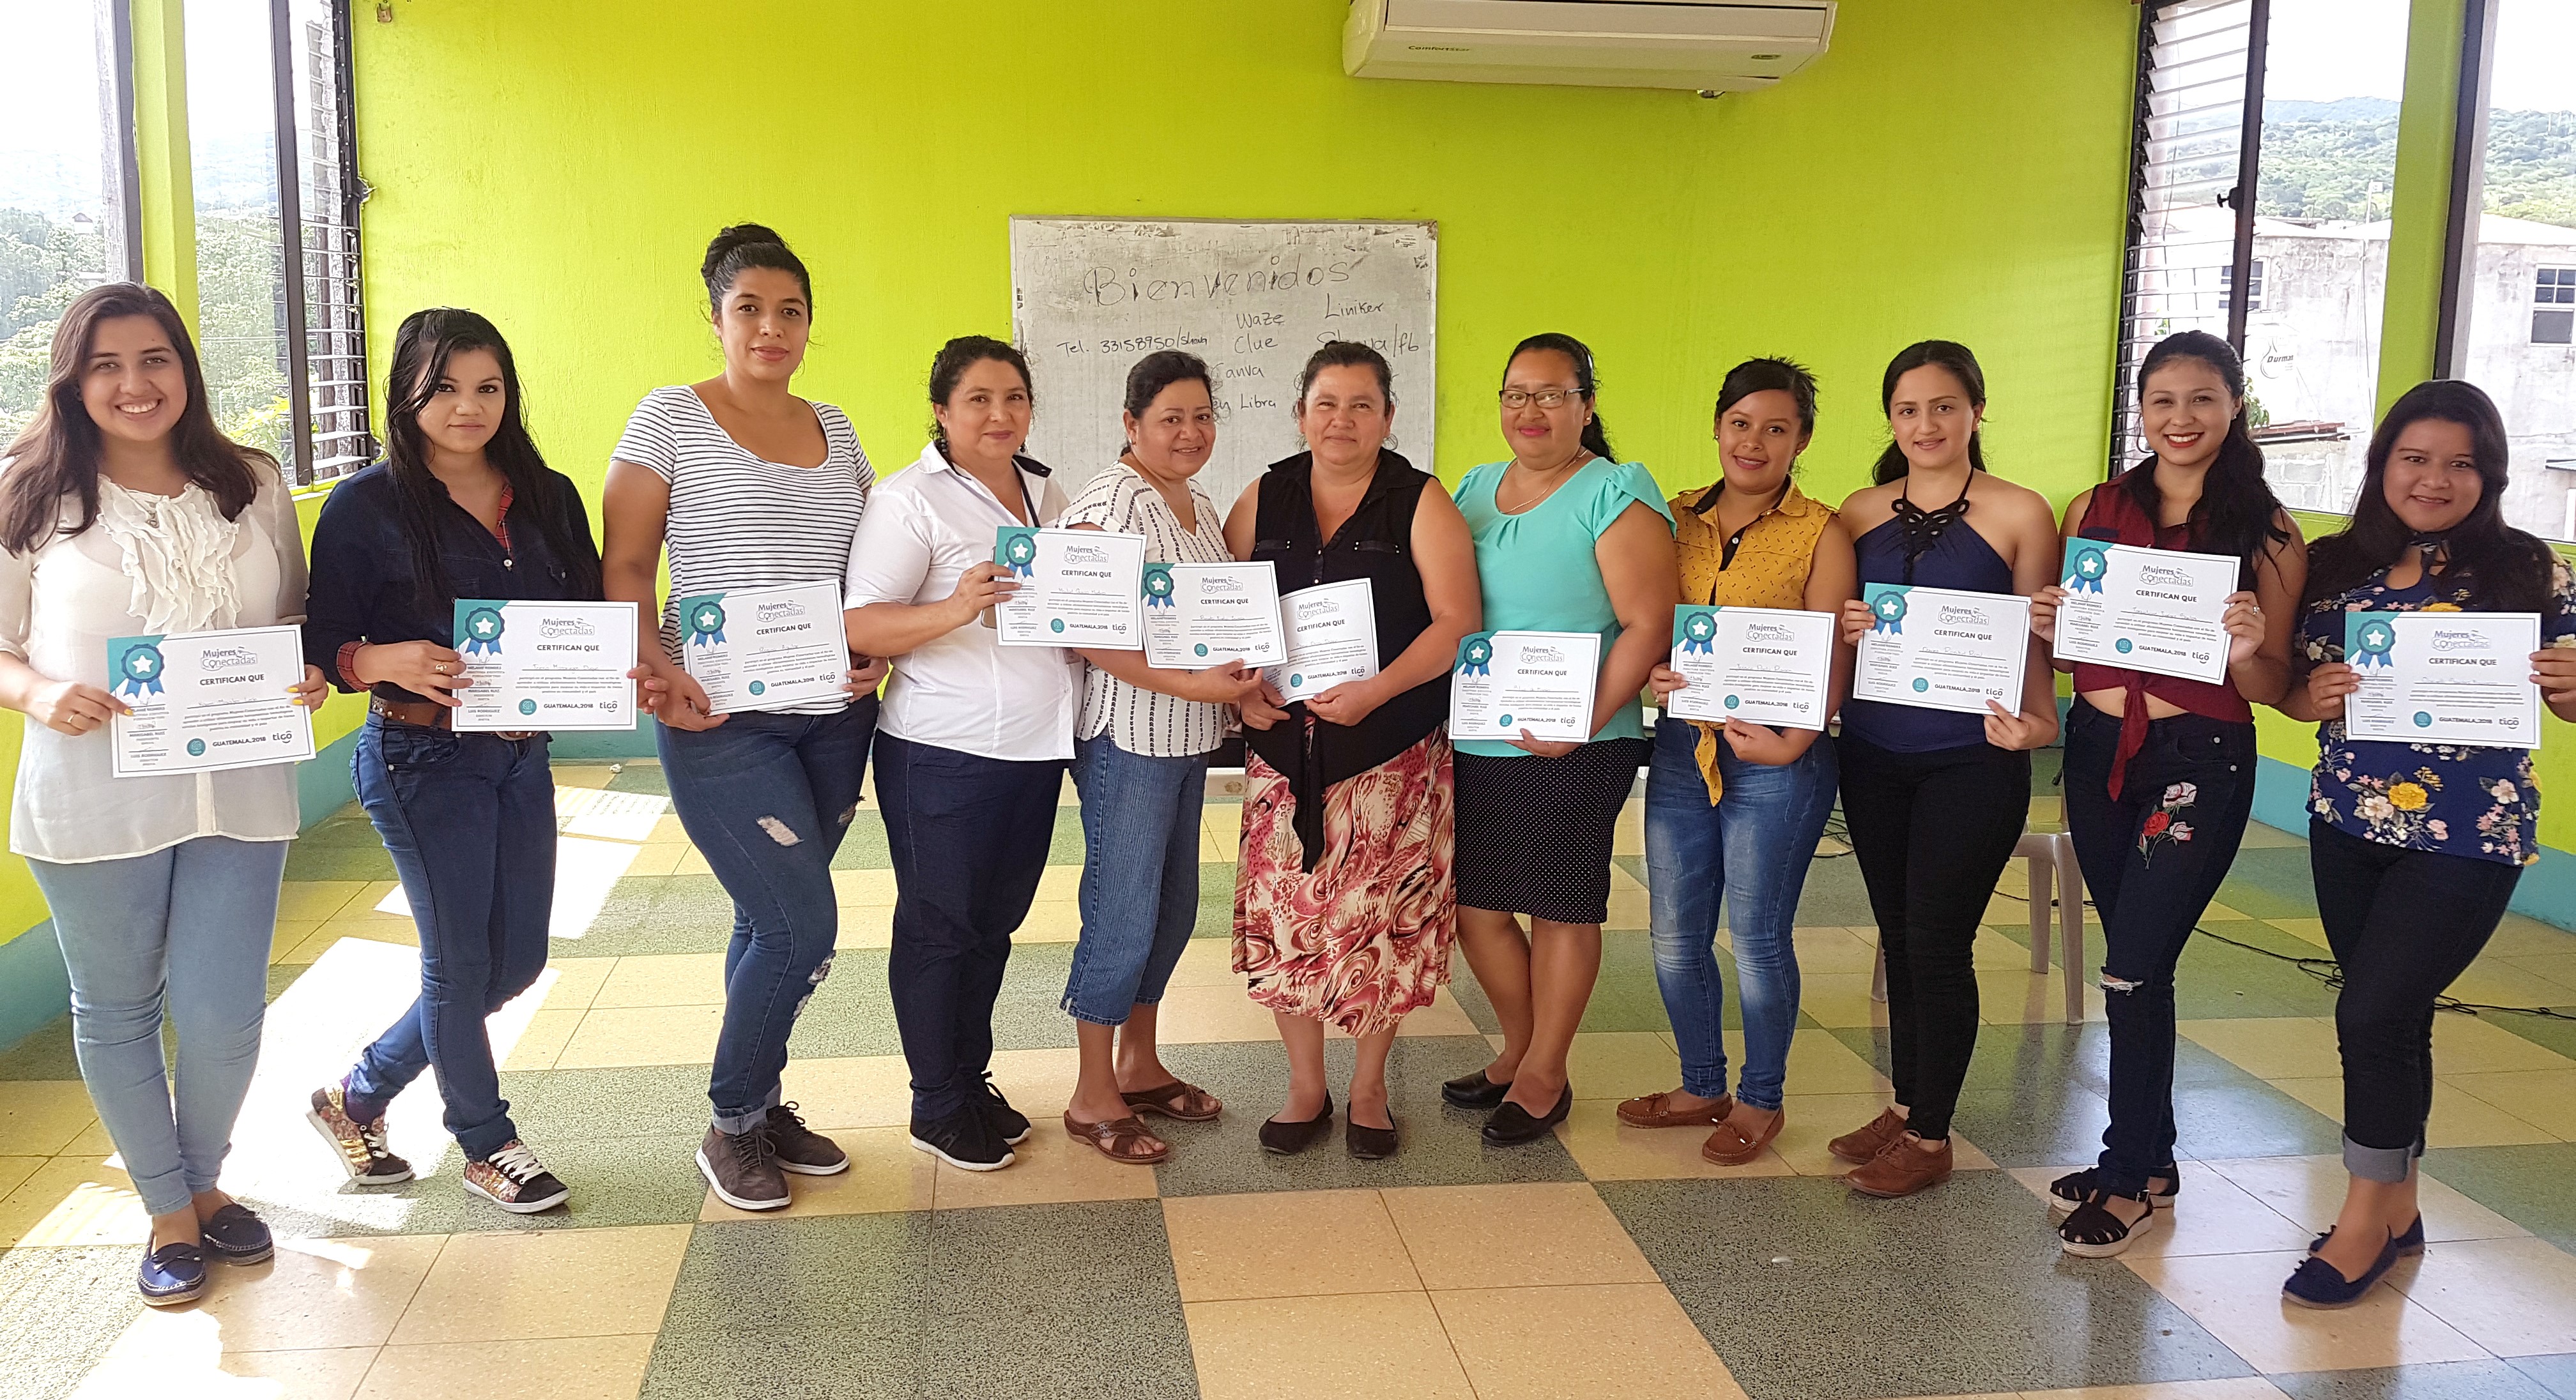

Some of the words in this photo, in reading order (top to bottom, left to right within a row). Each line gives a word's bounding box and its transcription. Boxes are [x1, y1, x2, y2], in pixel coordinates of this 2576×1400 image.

[1084, 255, 1349, 307] Bienvenidos
[1325, 293, 1384, 319] Liniker
[1236, 312, 1284, 329] Waze
[1057, 340, 1089, 357] Tel.
[1234, 333, 1278, 354] Clue
[2142, 565, 2174, 575] Mujeres
[2136, 590, 2179, 600] CERTIFICAN
[758, 602, 786, 611] Mujeres
[1942, 605, 1972, 614] Mujeres
[542, 618, 574, 627] Mujeres
[1297, 621, 1331, 632] CERTIFICAN
[756, 625, 795, 635] CERTIFICAN
[1935, 630, 1975, 639] CERTIFICAN
[203, 649, 236, 658] Mujeres
[200, 676, 245, 685] CERTIFICAN
[248, 674, 264, 682] QUE
